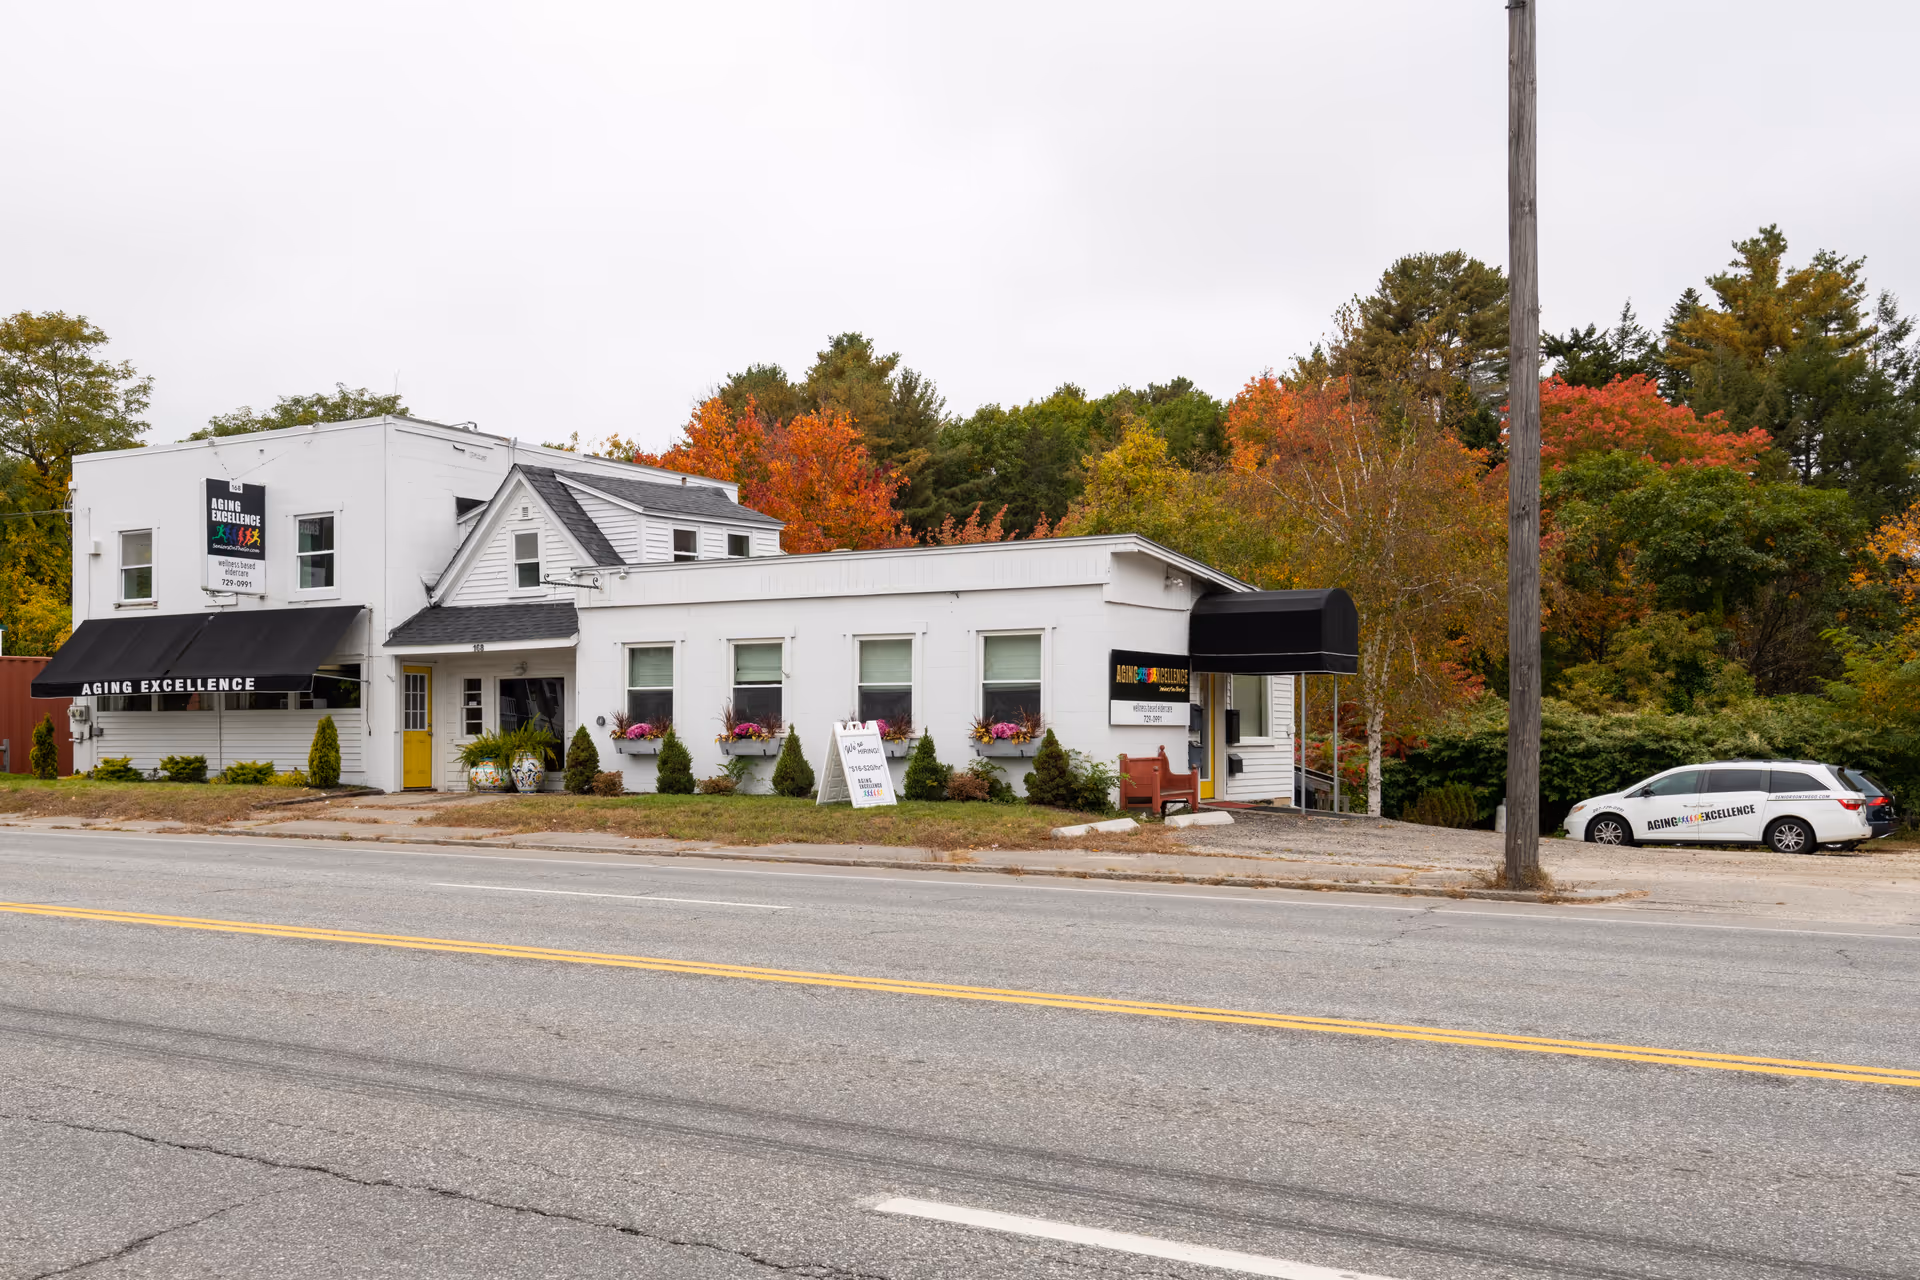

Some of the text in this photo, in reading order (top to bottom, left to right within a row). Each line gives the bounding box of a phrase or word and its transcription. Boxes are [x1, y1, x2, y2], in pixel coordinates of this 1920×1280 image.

[211, 498, 241, 512] AGING
[212, 510, 261, 526] EXCELLENCE
[218, 560, 256, 570] wellness based
[224, 568, 249, 577] eldercare
[221, 579, 252, 588] 729-0991
[1116, 665, 1139, 684] AGING
[81, 677, 256, 696] AGING EXCELLENCE
[1647, 804, 1756, 831] AGING EXCELLENCE
